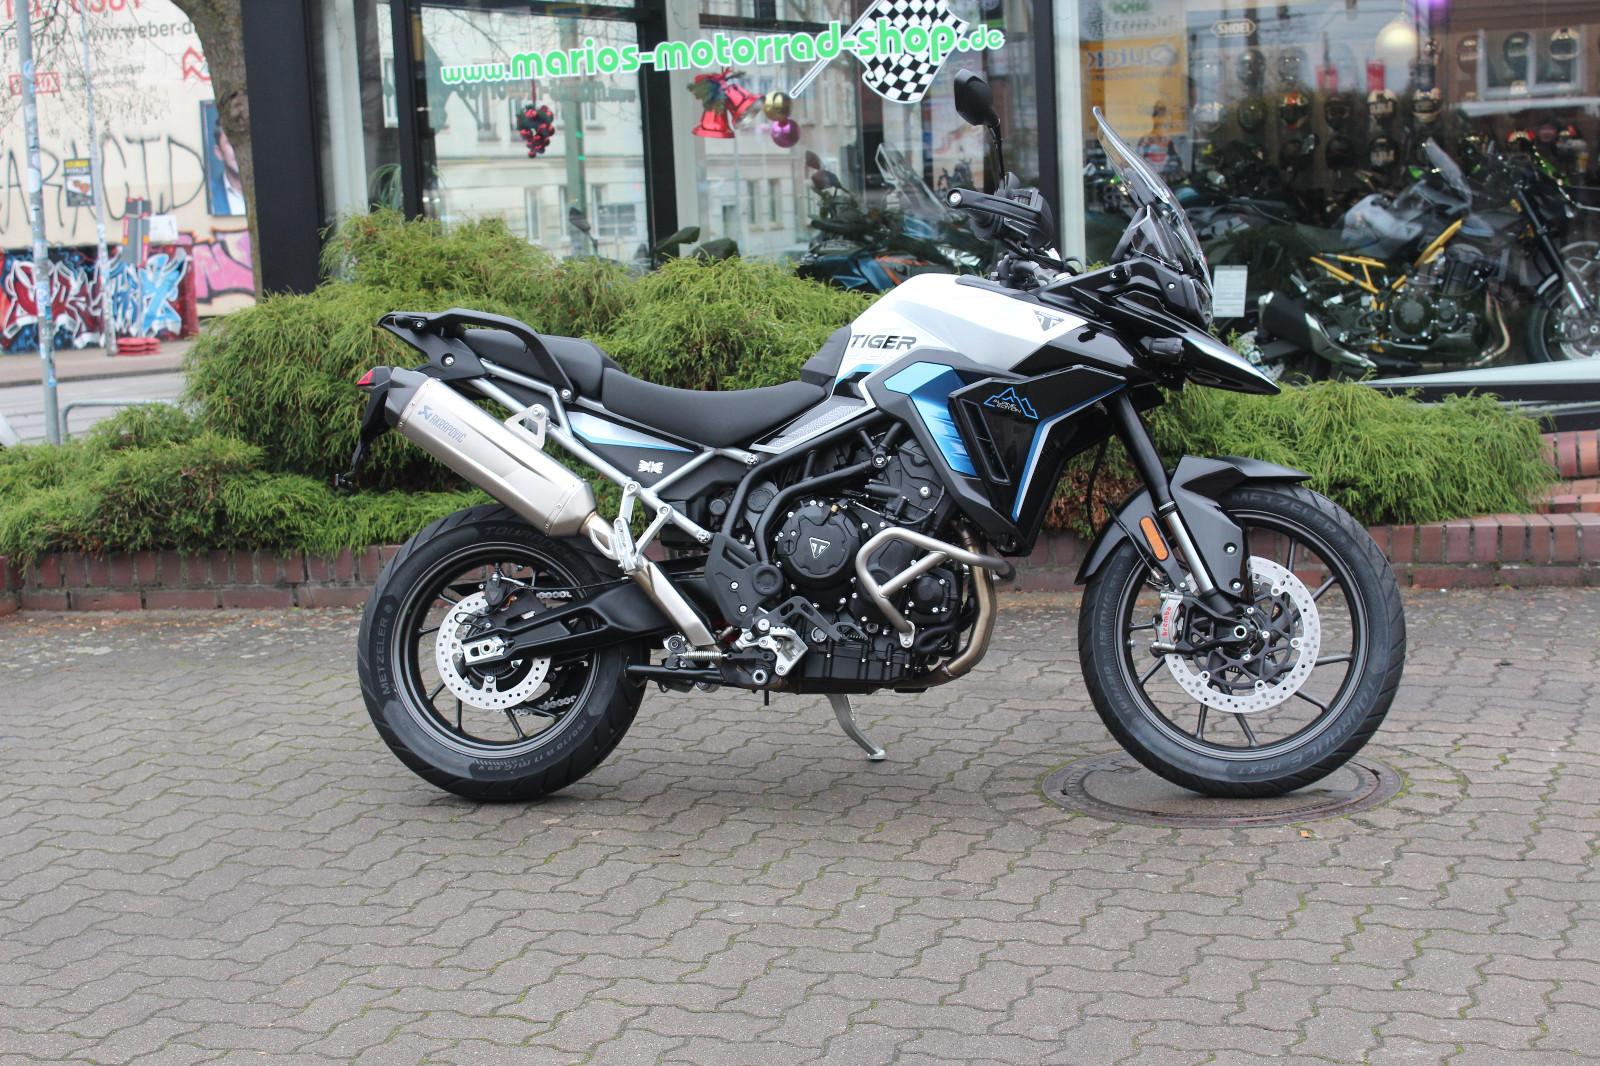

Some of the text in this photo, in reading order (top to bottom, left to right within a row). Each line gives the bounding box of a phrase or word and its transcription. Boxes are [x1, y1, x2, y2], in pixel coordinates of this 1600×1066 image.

[441, 17, 1005, 84] www.marios-motorrad-shop.de
[850, 334, 917, 350] TIGER
[1160, 606, 1171, 638] brembo
[376, 617, 391, 696] METZELER
